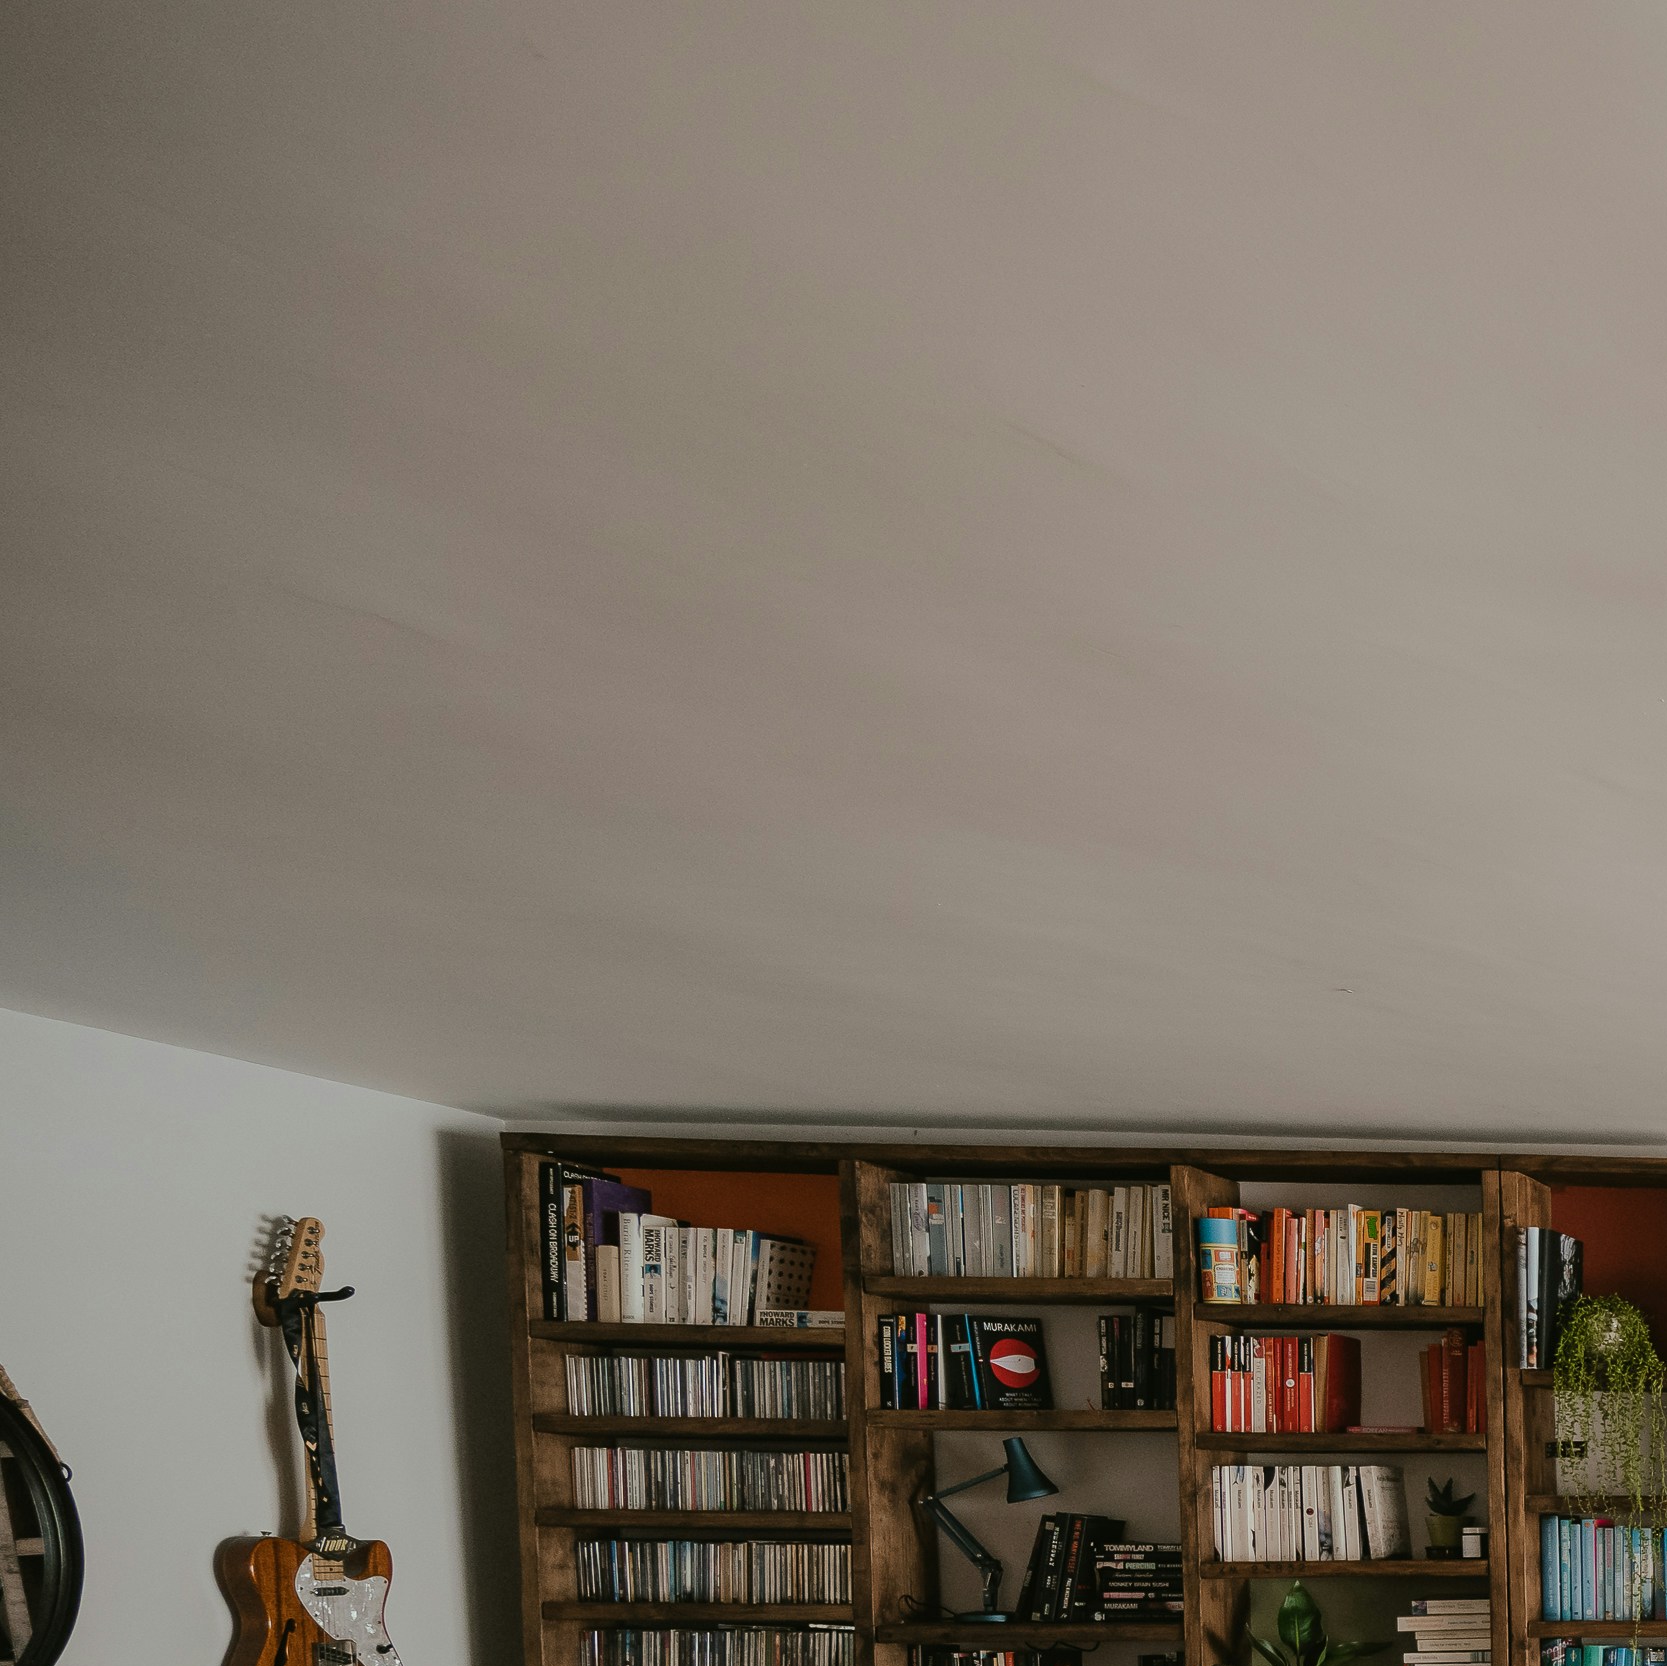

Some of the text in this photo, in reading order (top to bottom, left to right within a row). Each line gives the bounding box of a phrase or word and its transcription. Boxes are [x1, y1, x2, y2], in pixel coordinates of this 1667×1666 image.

[1162, 1189, 1169, 1201] MR
[548, 1203, 558, 1228] CLASH
[549, 1229, 557, 1240] ON
[622, 1218, 632, 1273] Burial Rites
[645, 1229, 654, 1262] MARKS
[550, 1241, 559, 1283] BROADWAY
[759, 1318, 794, 1327] MARKS
[983, 1321, 1037, 1332] MURAKAMI
[1049, 1527, 1060, 1567] HEMINGWAY
[1104, 1544, 1154, 1552] TOMMYLAND
[1125, 1562, 1156, 1570] PIERCING
